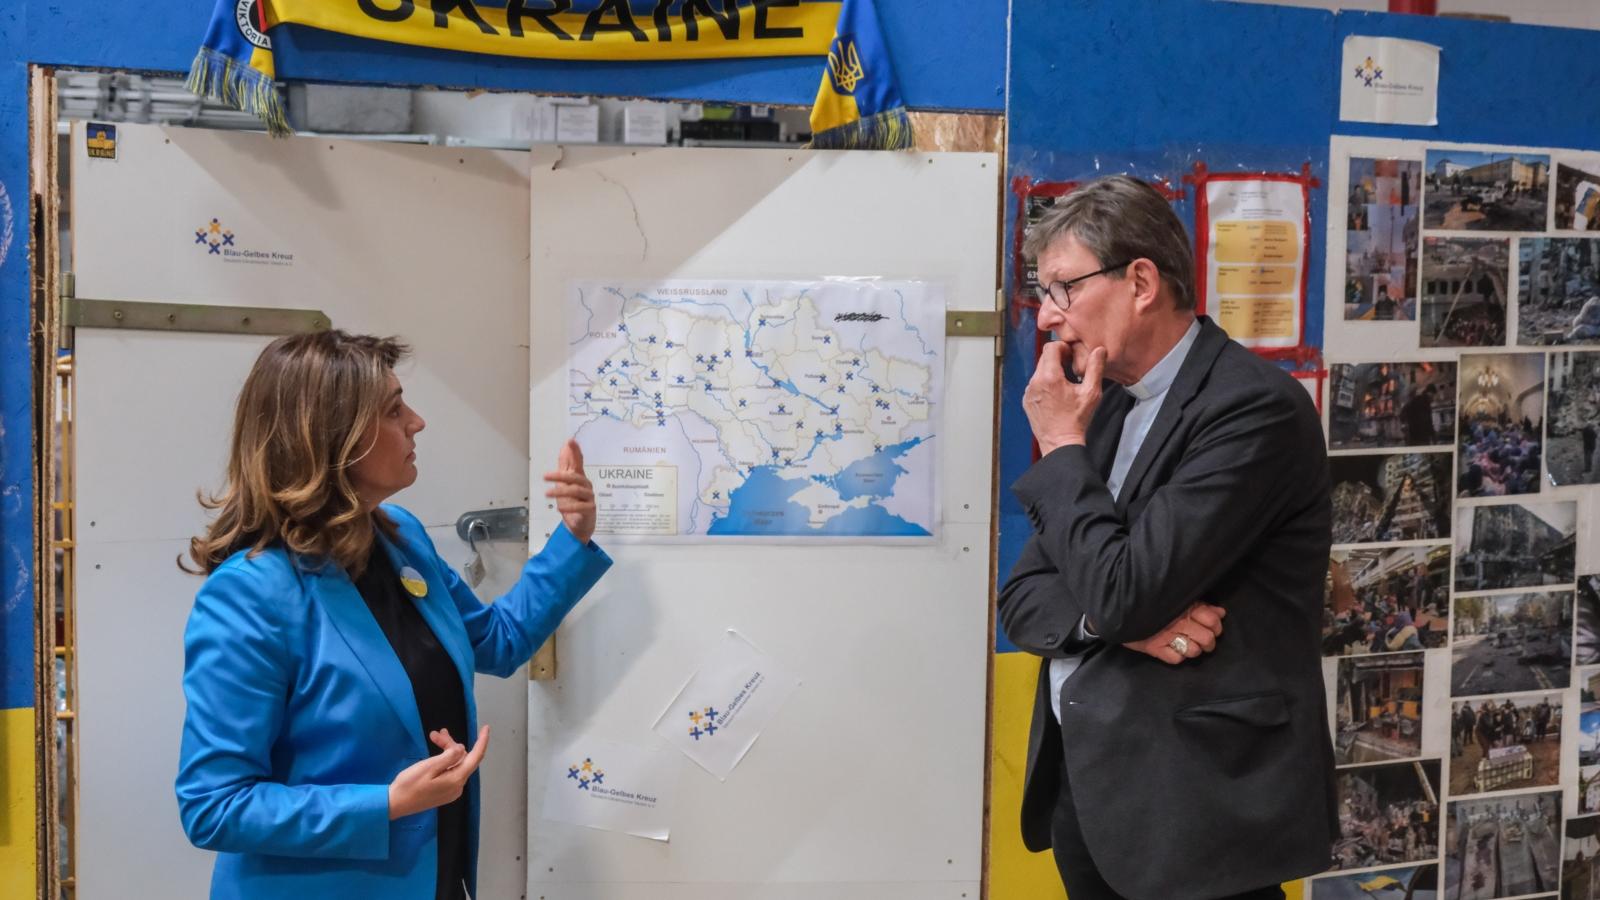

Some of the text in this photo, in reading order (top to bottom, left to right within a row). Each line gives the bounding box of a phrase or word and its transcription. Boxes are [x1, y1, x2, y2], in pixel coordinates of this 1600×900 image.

[239, 0, 269, 46] VIKTORIA
[271, 252, 293, 260] Kreuz
[656, 288, 728, 296] WEISSRUSSLAND
[589, 331, 617, 339] POLEN
[623, 446, 667, 454] RUMÄNIEN
[598, 469, 654, 480] UKRAINE
[636, 793, 657, 803] Kreuz
